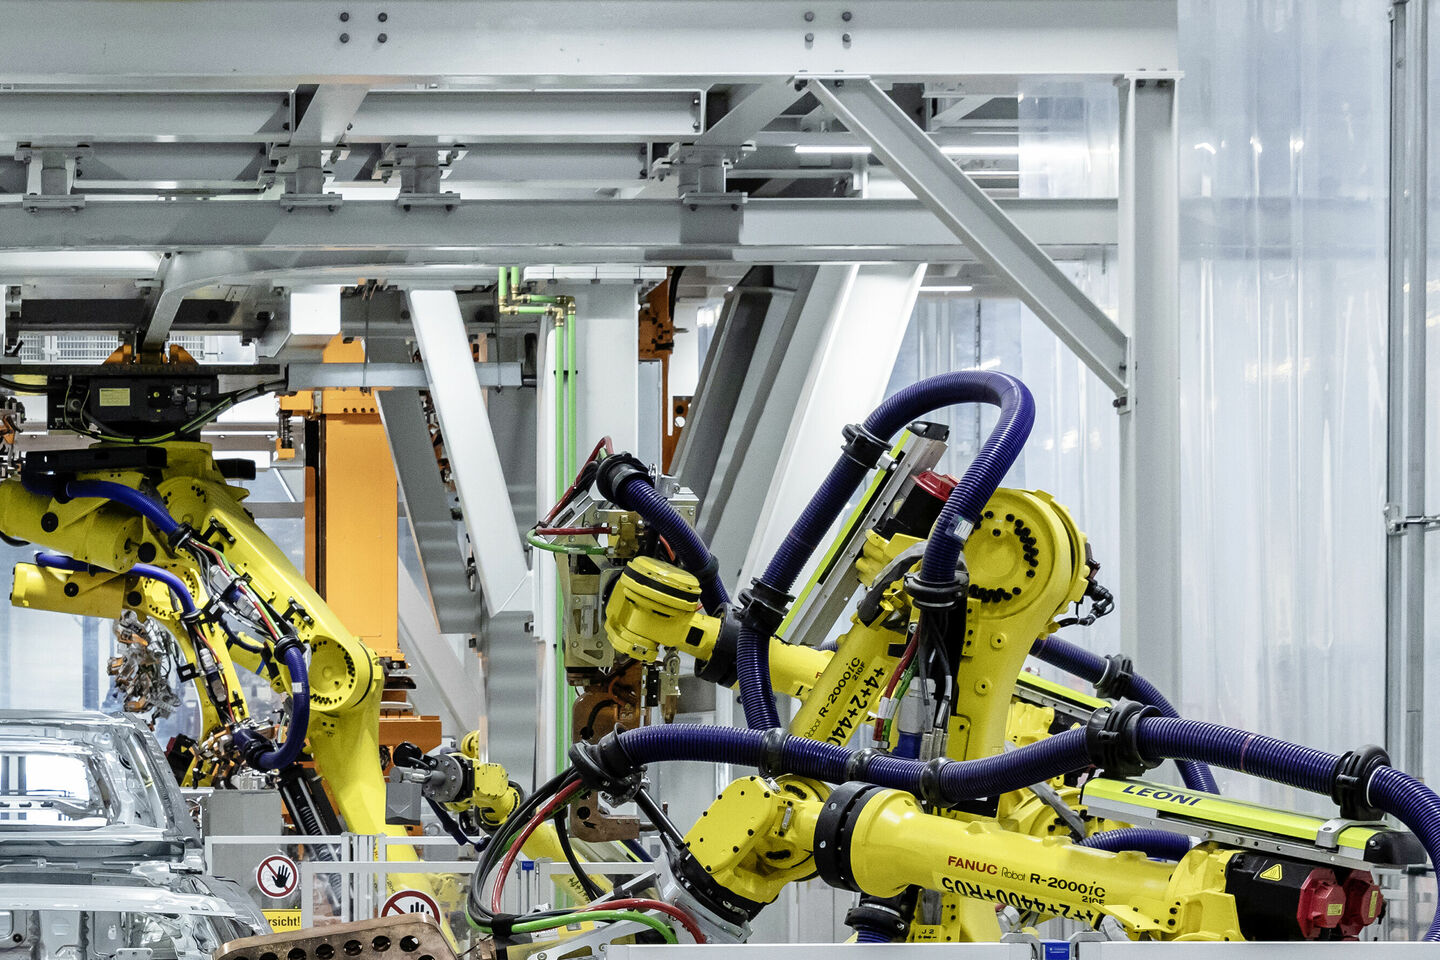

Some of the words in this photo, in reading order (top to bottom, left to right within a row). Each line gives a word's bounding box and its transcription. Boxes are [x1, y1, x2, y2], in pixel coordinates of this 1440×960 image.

[851, 660, 866, 681] 210F
[1122, 785, 1202, 806] LEONI
[947, 855, 998, 875] FANUC
[1001, 867, 1026, 881] Robot
[1030, 872, 1106, 898] R-2000iC
